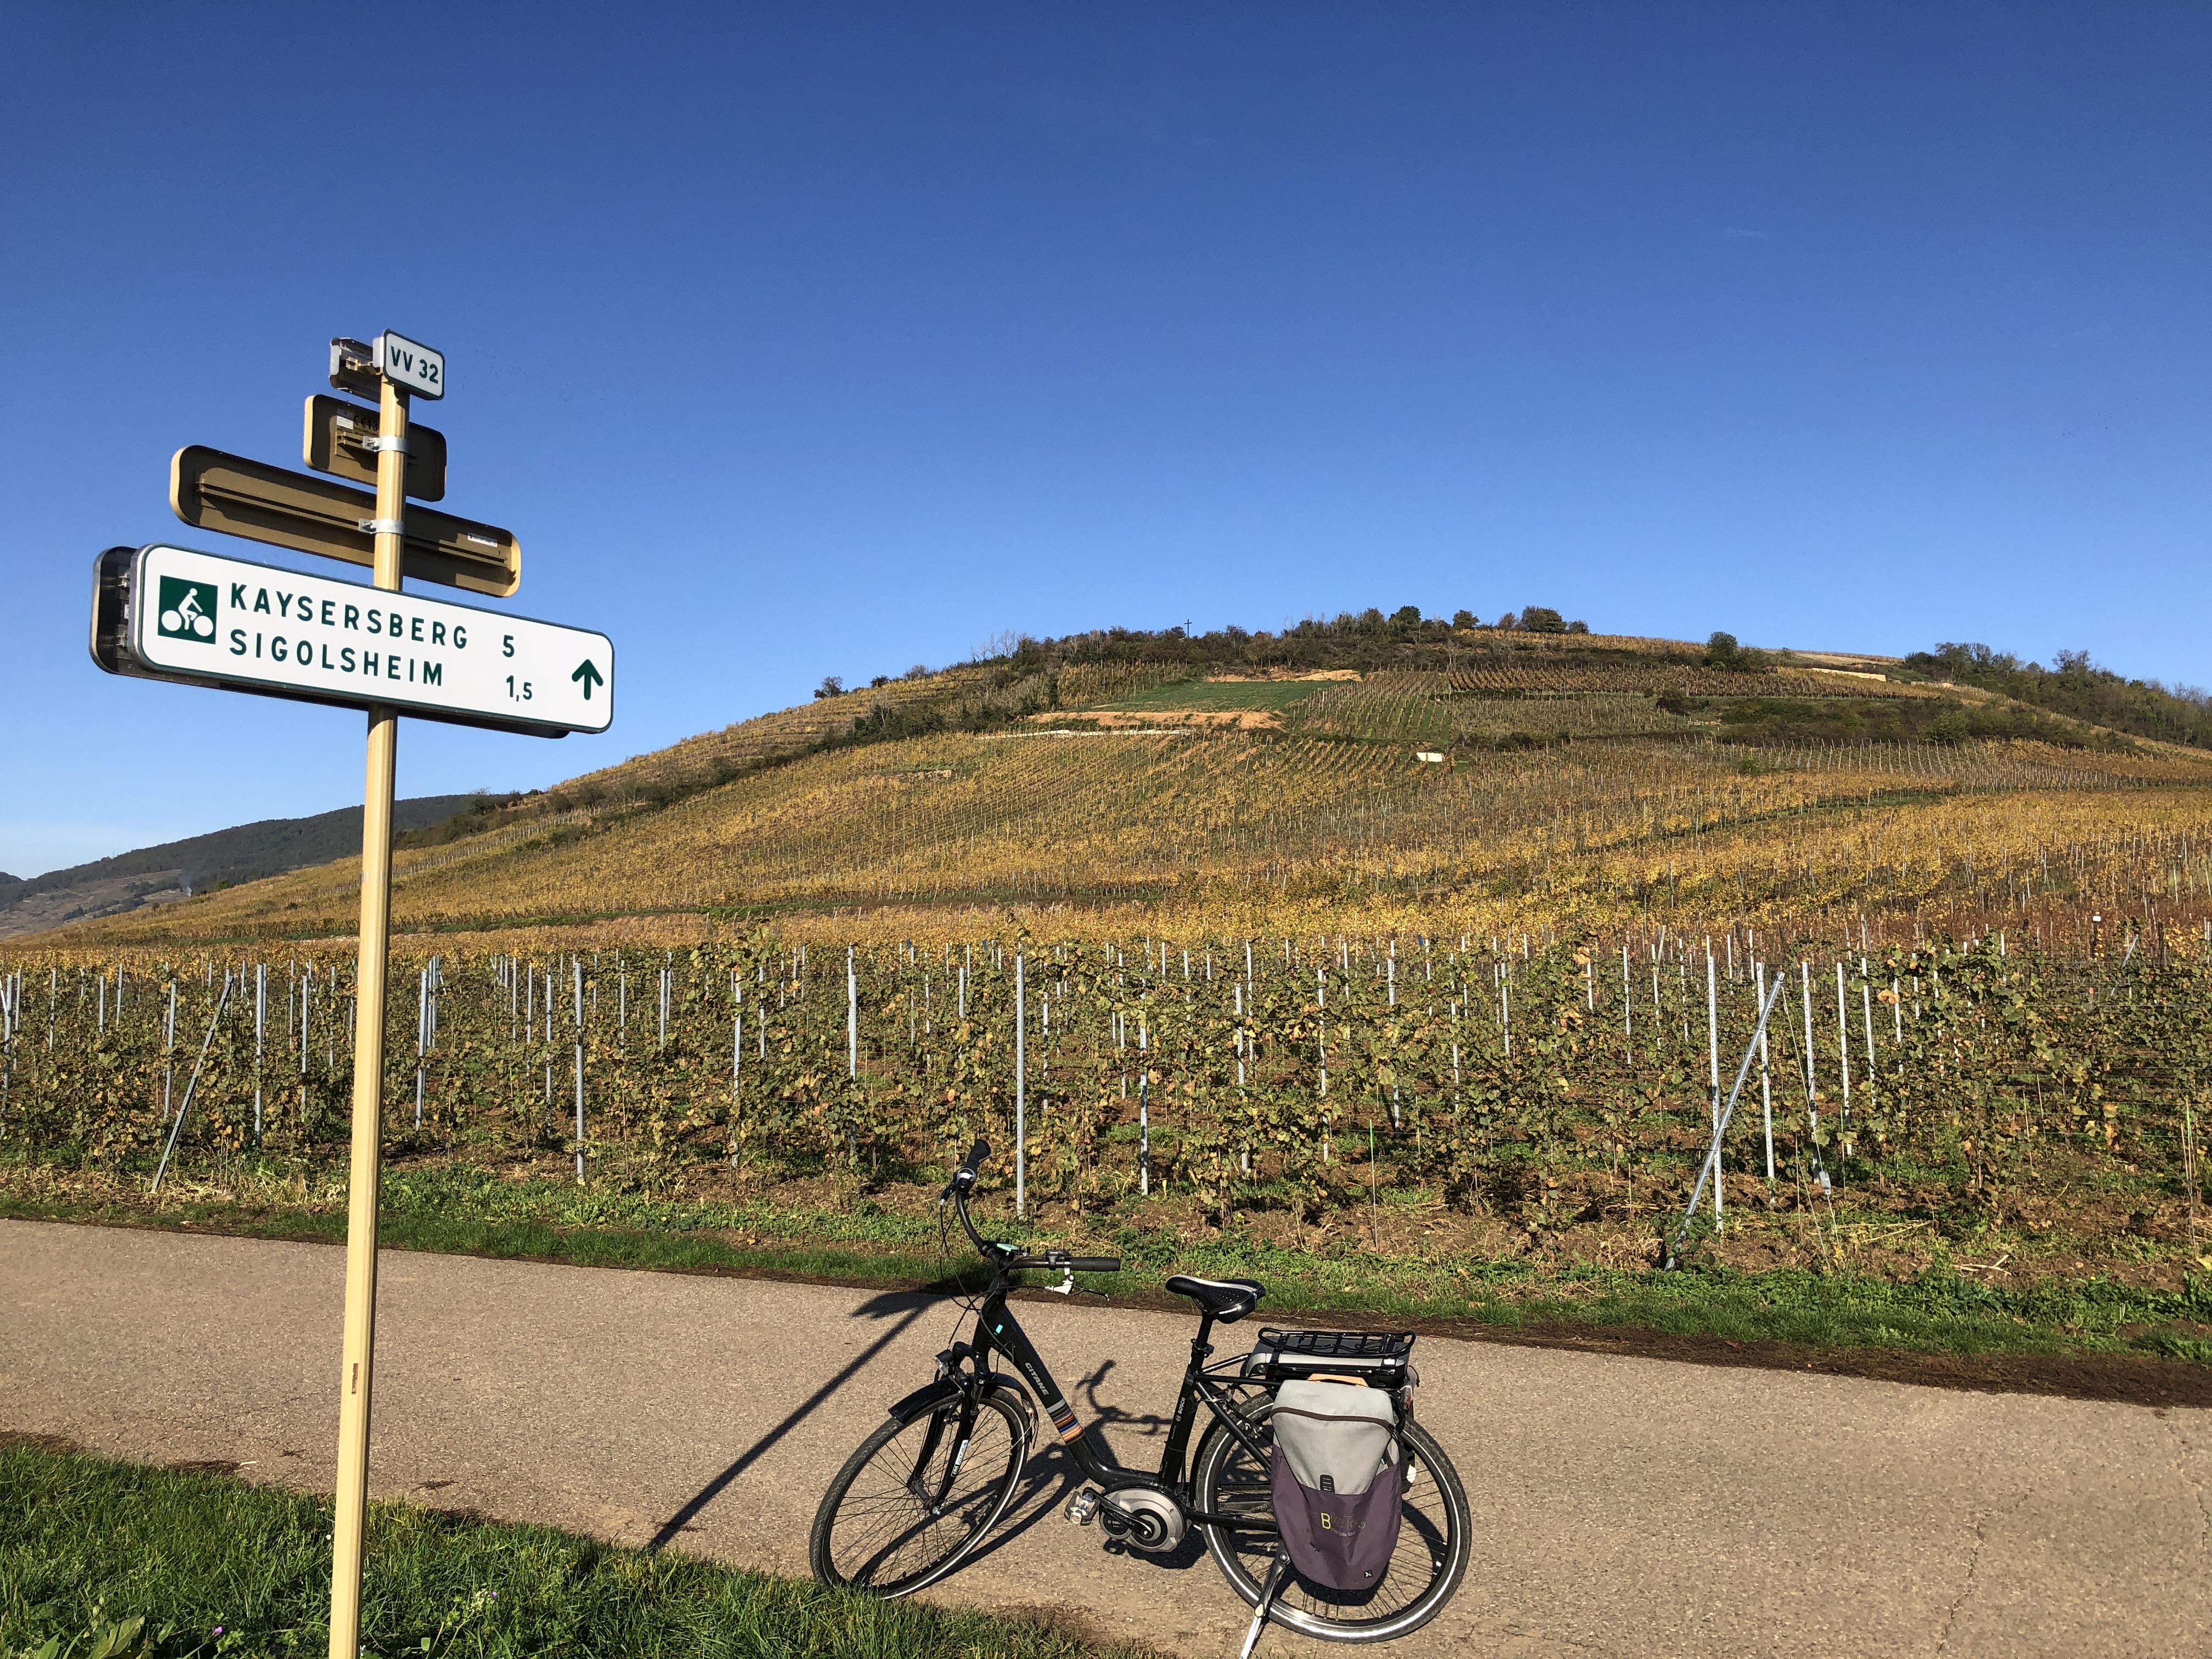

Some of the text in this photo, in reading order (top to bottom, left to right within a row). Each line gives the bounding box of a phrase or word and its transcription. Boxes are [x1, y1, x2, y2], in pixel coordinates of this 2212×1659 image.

[390, 346, 439, 385] VV 32
[230, 582, 515, 658] KAYSERSBERG 5
[229, 629, 533, 702] SIGOLSHEIM 1,5
[1025, 1362, 1049, 1396] GITANE
[1177, 1397, 1186, 1414] BOSCH
